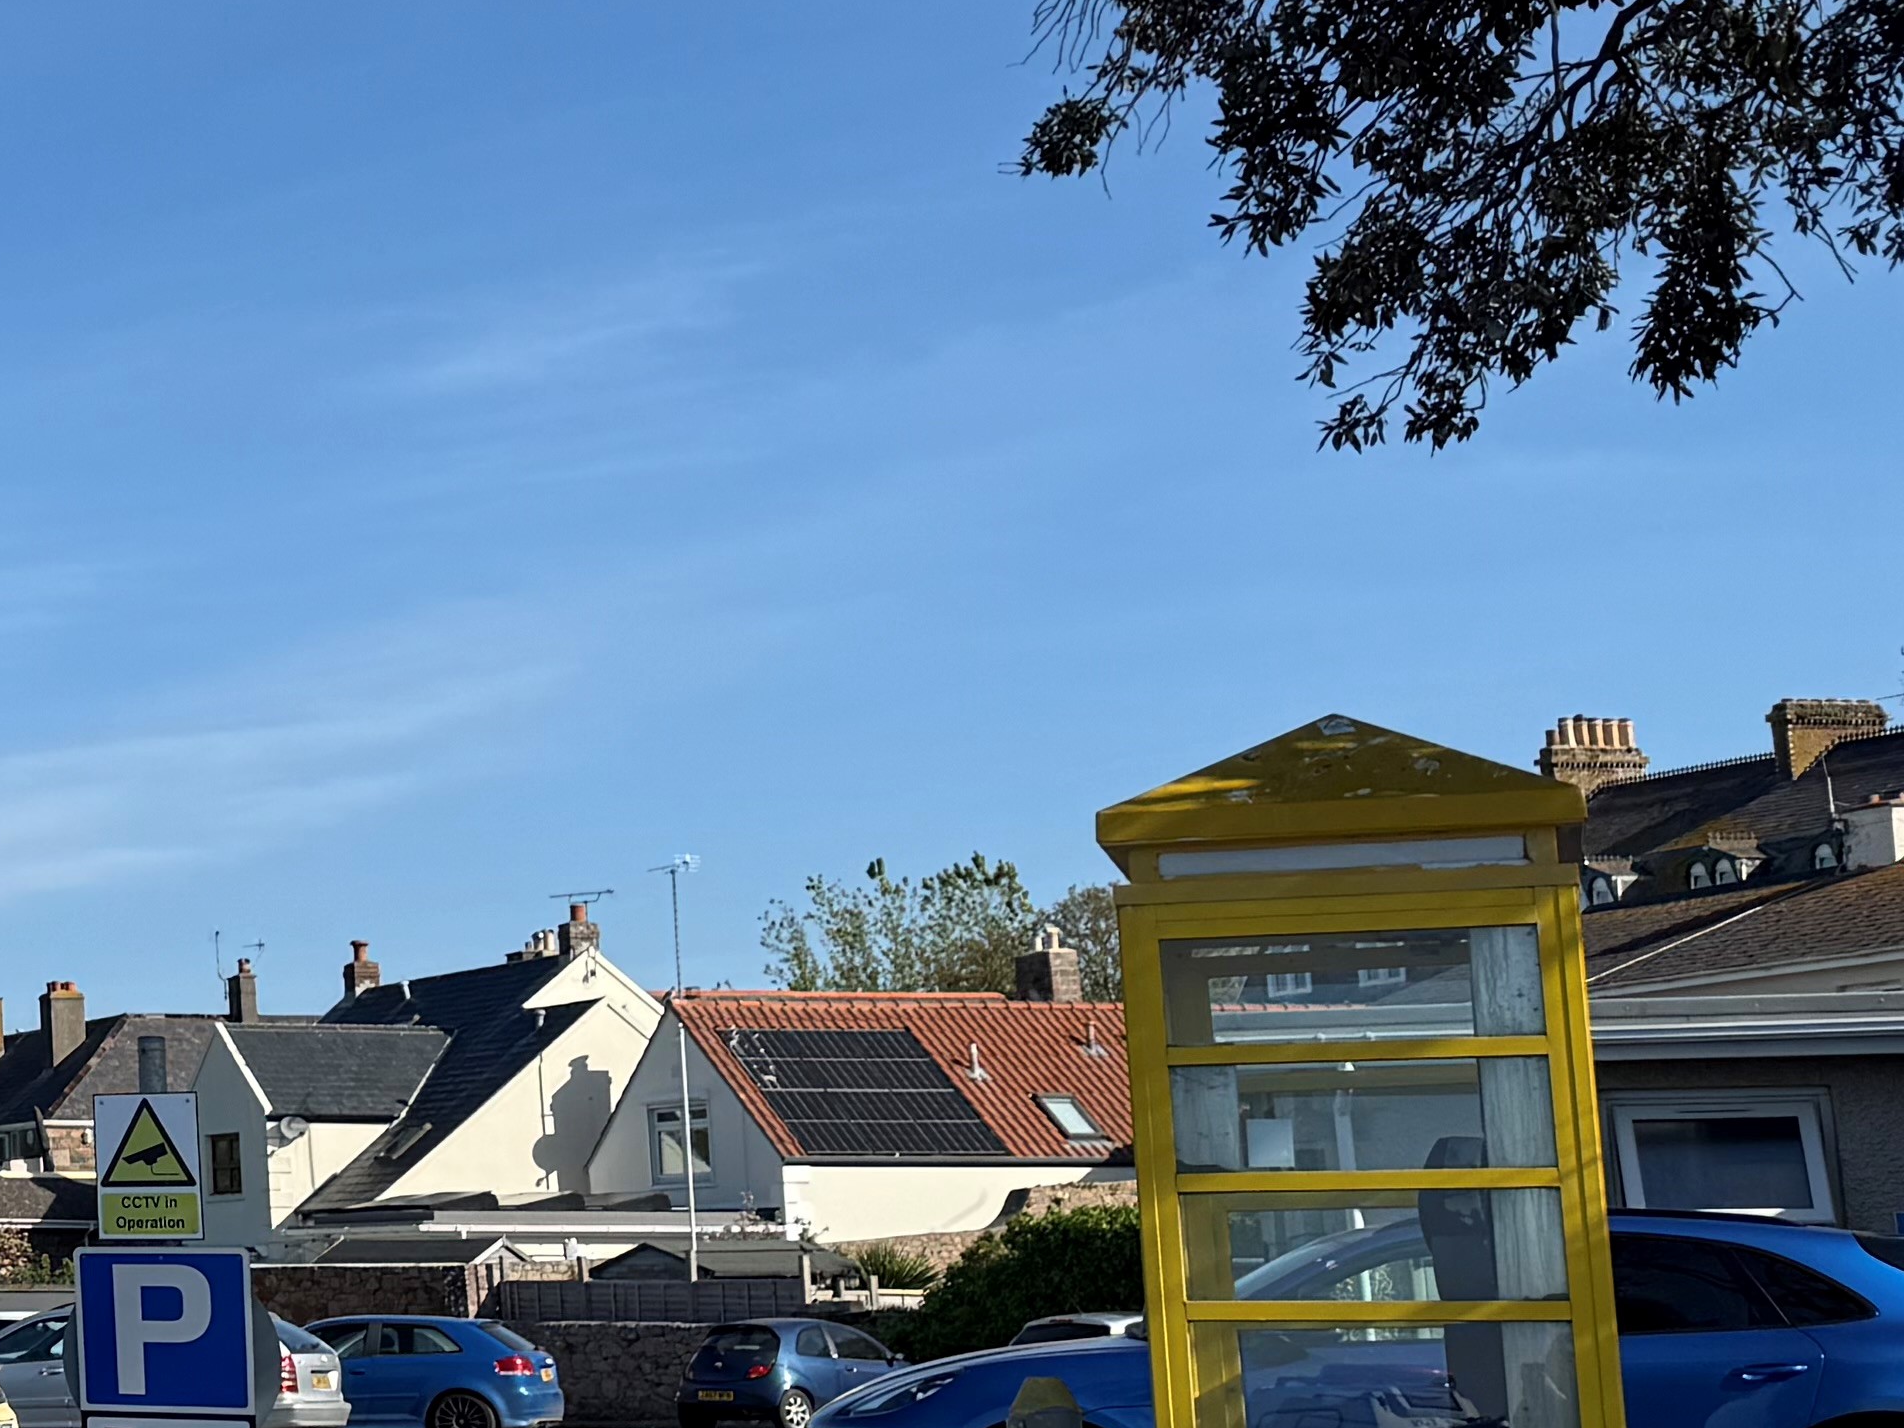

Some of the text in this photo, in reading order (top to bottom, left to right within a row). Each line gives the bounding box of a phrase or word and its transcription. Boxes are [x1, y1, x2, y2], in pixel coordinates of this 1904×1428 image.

[121, 1196, 160, 1209] CCTV
[116, 1216, 185, 1231] Operation
[112, 1263, 211, 1396] P
